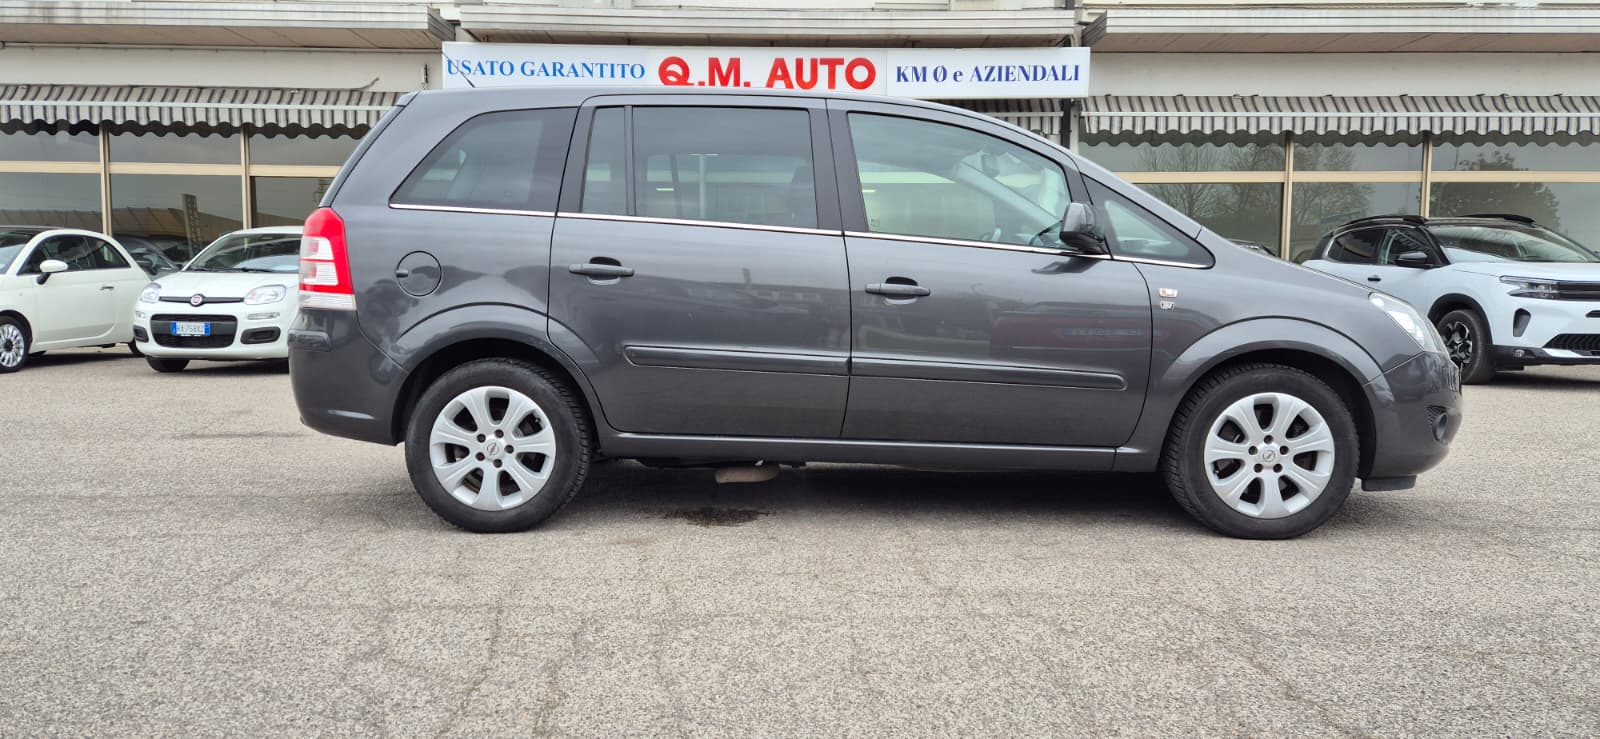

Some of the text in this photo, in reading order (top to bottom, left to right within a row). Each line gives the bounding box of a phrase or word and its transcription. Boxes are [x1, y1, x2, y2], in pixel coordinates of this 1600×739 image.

[446, 59, 646, 80] USATO GARANTITO
[658, 56, 877, 90] Q.M. AUTO
[896, 65, 928, 83] KM
[952, 69, 963, 82] e
[969, 64, 1080, 83] AZIENDALI
